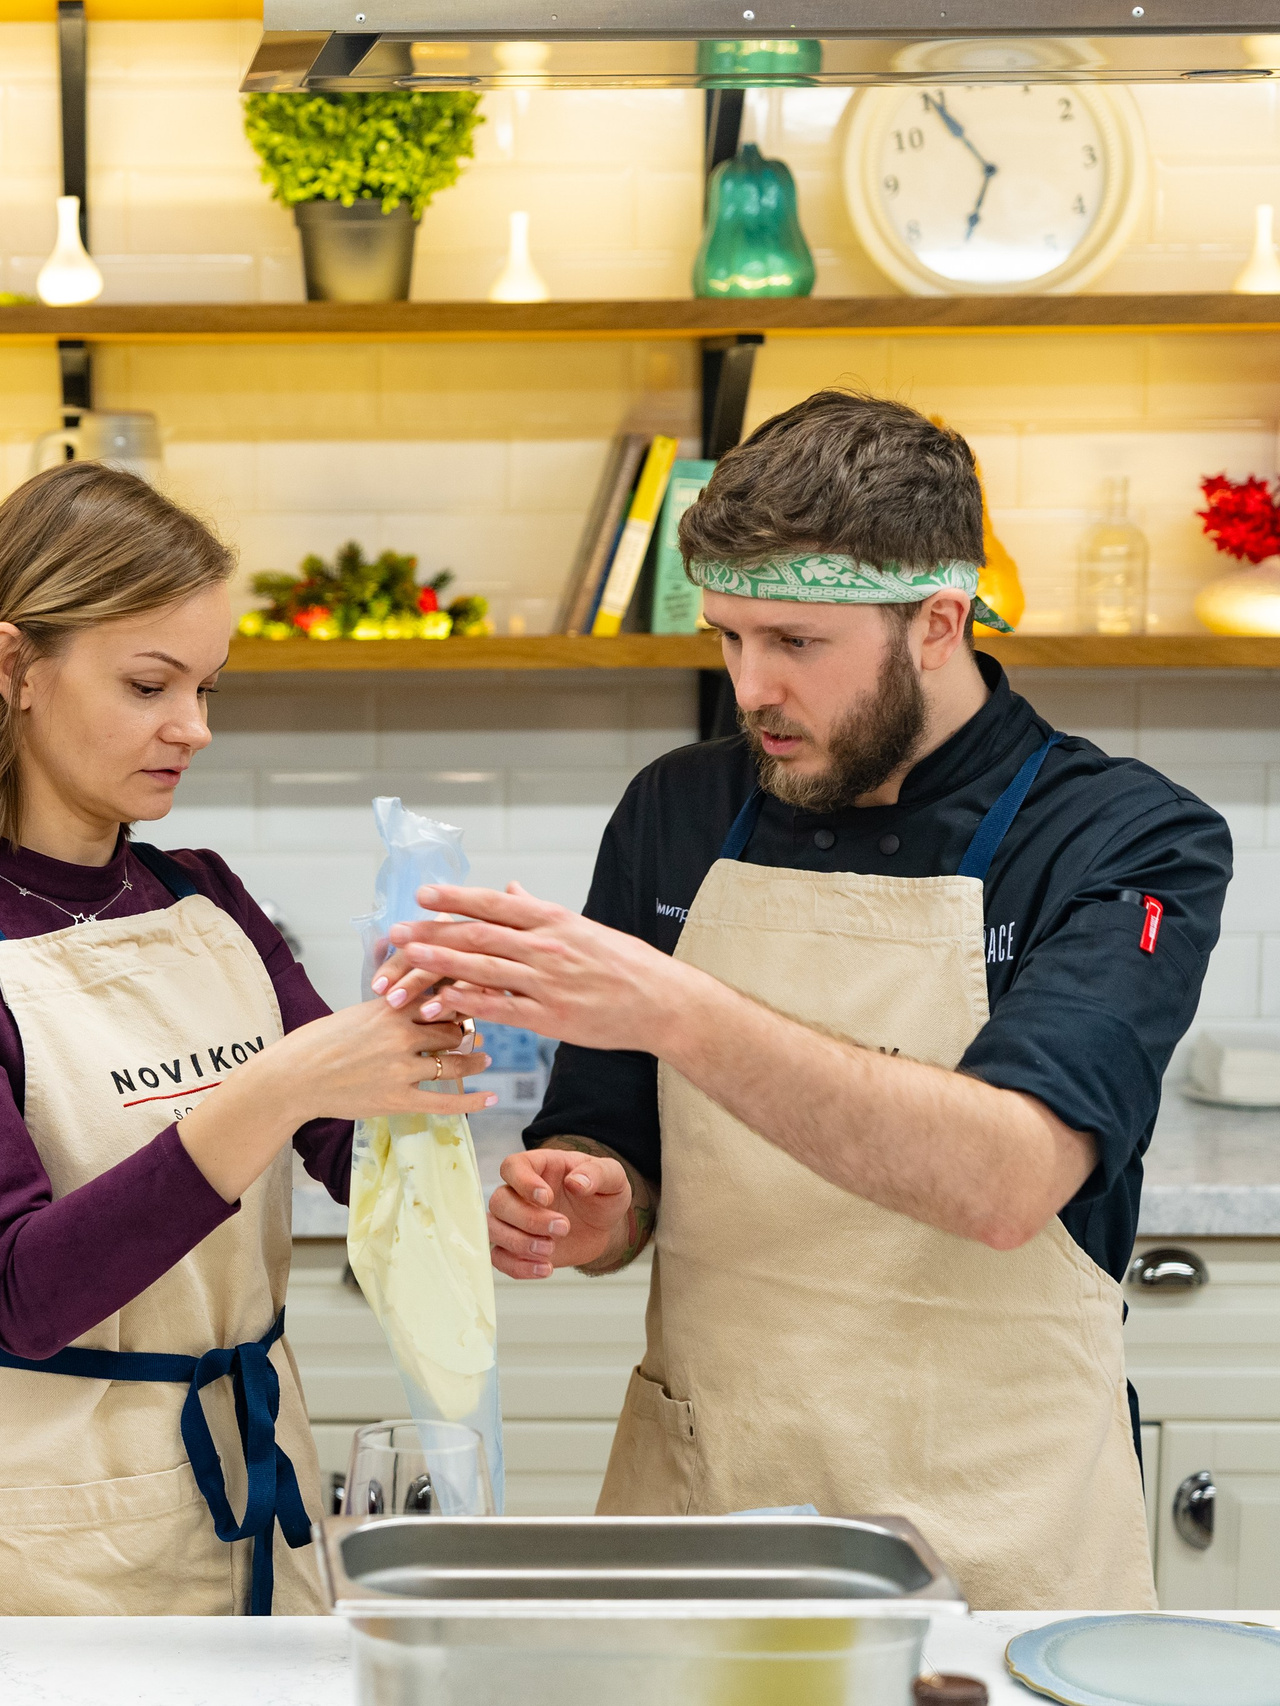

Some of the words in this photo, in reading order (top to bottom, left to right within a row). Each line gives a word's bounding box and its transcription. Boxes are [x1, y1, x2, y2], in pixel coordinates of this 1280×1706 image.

[1058, 97, 1073, 121] 2
[893, 127, 924, 151] 10
[1083, 146, 1097, 168] 3
[884, 174, 899, 197] 9
[1072, 195, 1086, 214] 4
[655, 897, 689, 923] митр
[983, 921, 1016, 963] ACE
[110, 1035, 265, 1095] NOVIKOV
